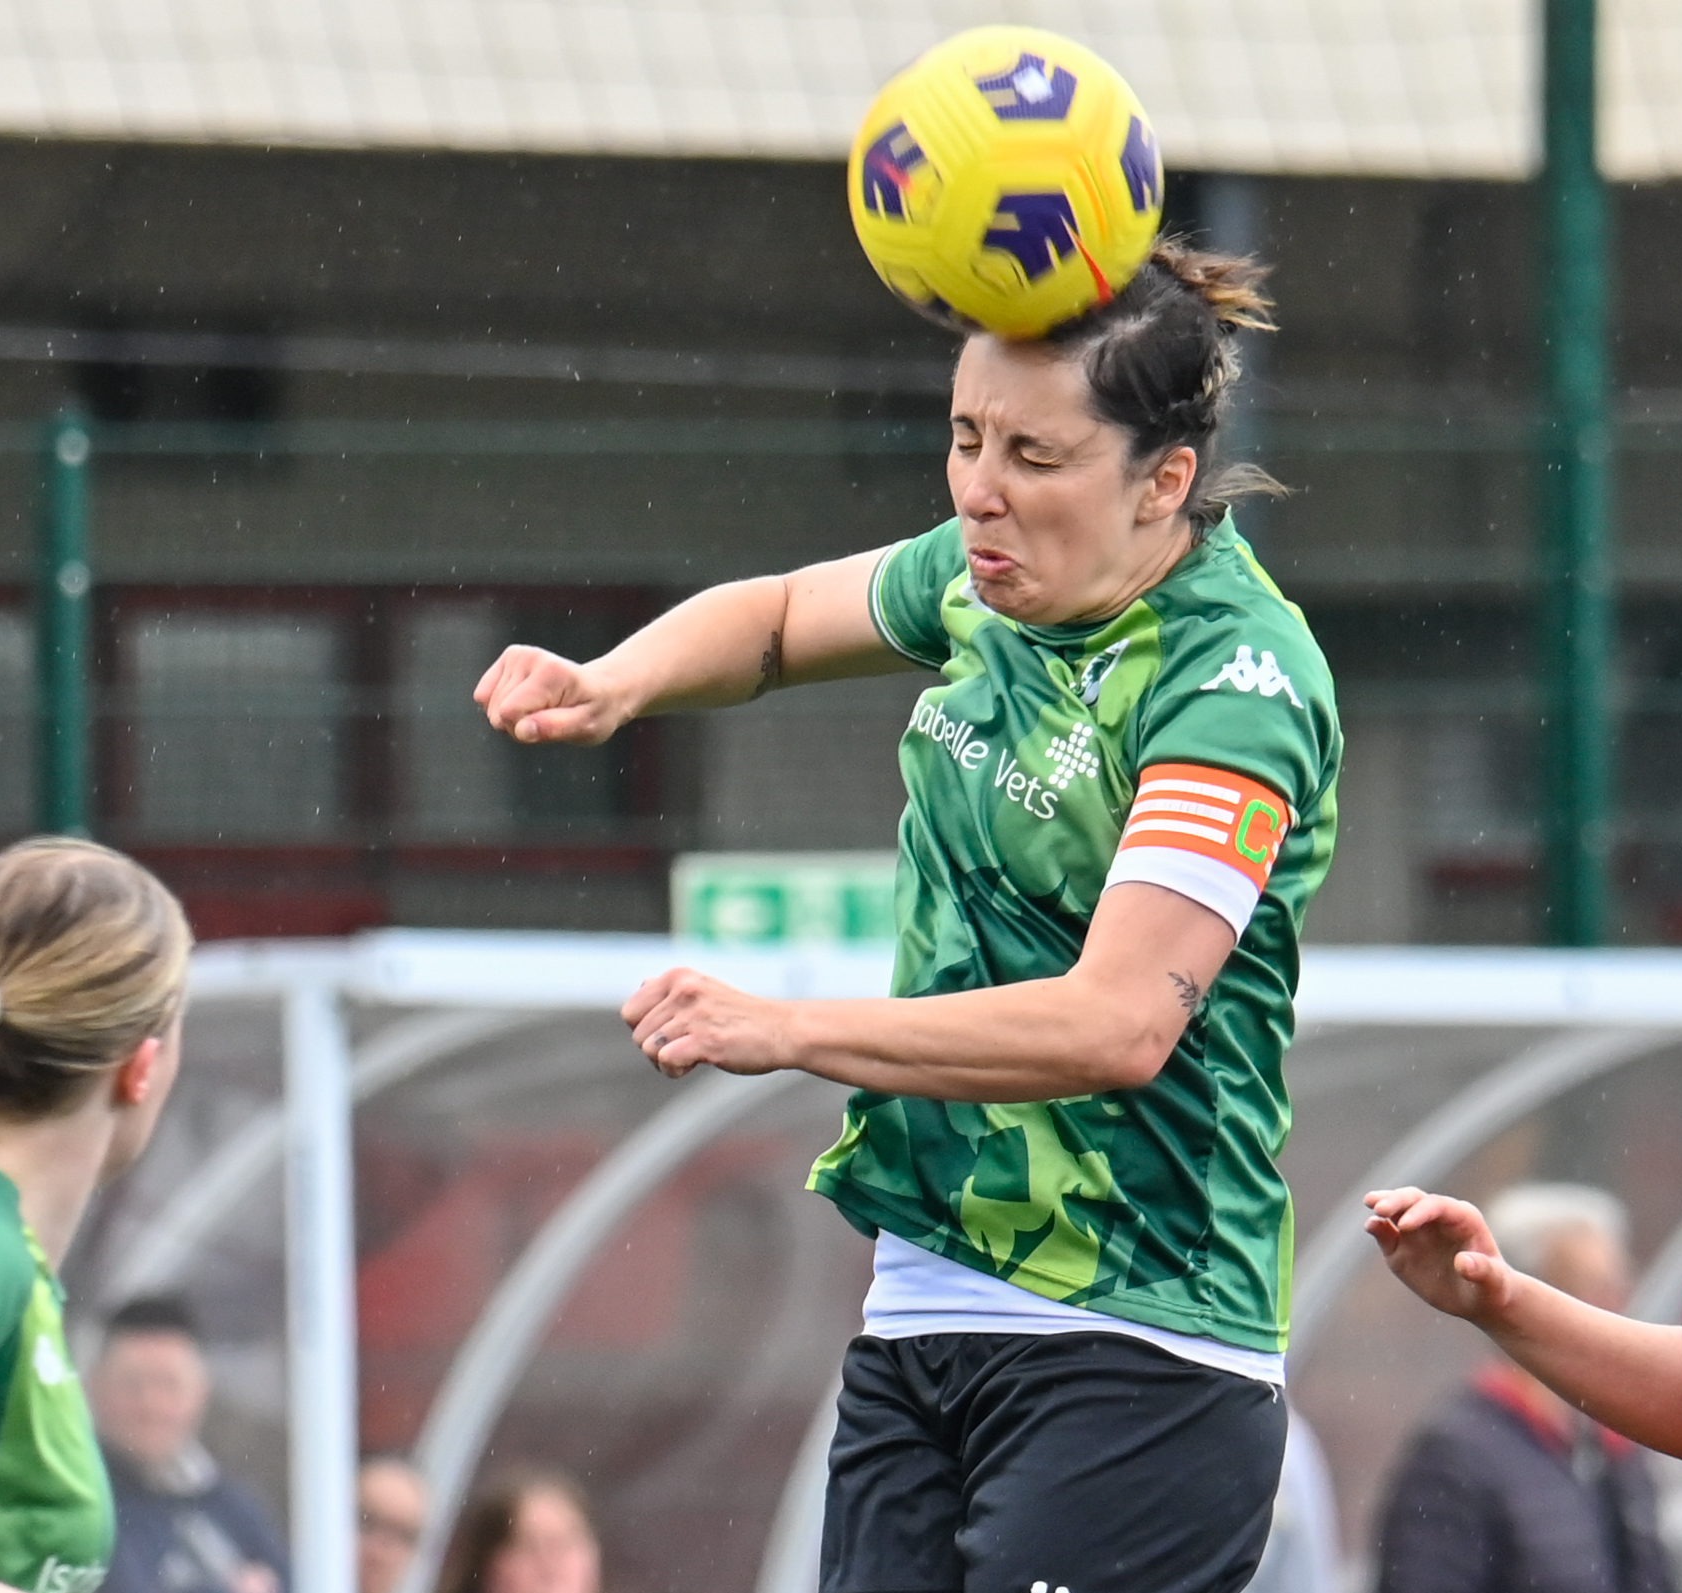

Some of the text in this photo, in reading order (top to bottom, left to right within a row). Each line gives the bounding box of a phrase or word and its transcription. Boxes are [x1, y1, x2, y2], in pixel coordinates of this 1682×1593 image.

[908, 699, 1059, 820] sabelle Vets
[1235, 799, 1279, 864] C
